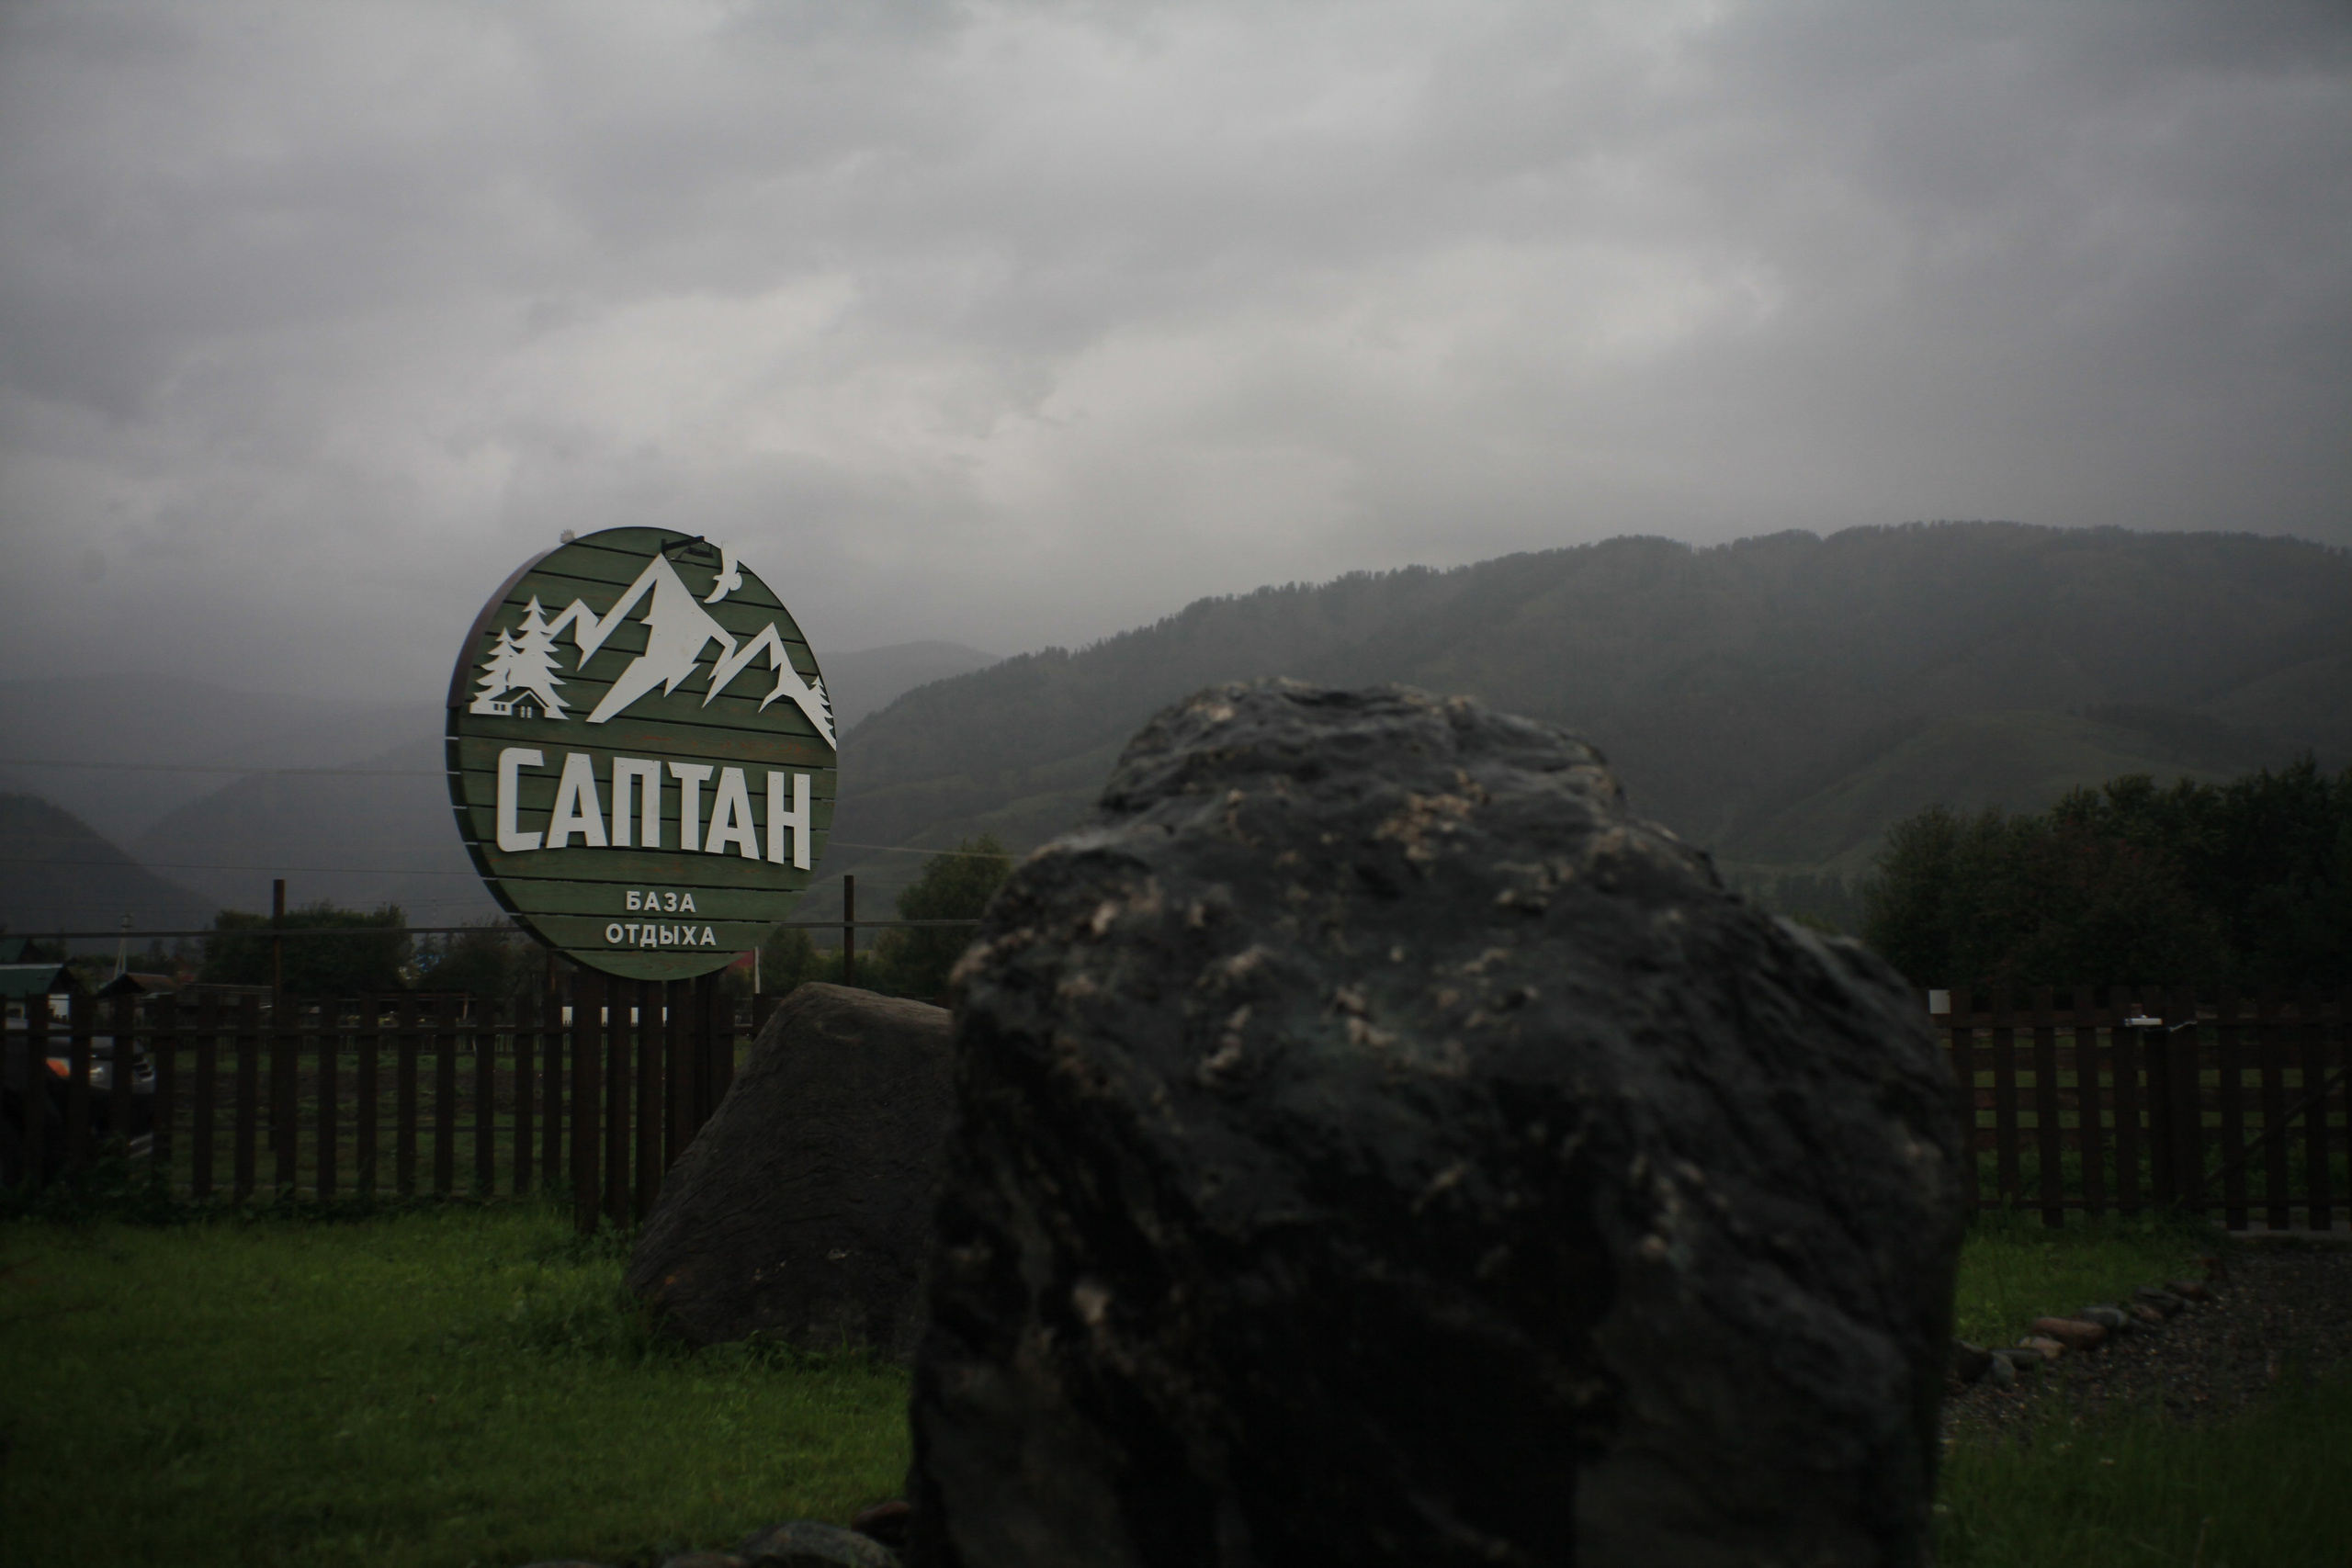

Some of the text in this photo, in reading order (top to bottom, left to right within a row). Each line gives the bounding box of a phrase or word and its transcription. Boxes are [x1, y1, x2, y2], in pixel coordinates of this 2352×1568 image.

[496, 747, 810, 870] САПТАН
[626, 890, 696, 913] БАЗА
[605, 923, 717, 947] ОТДЫХА
